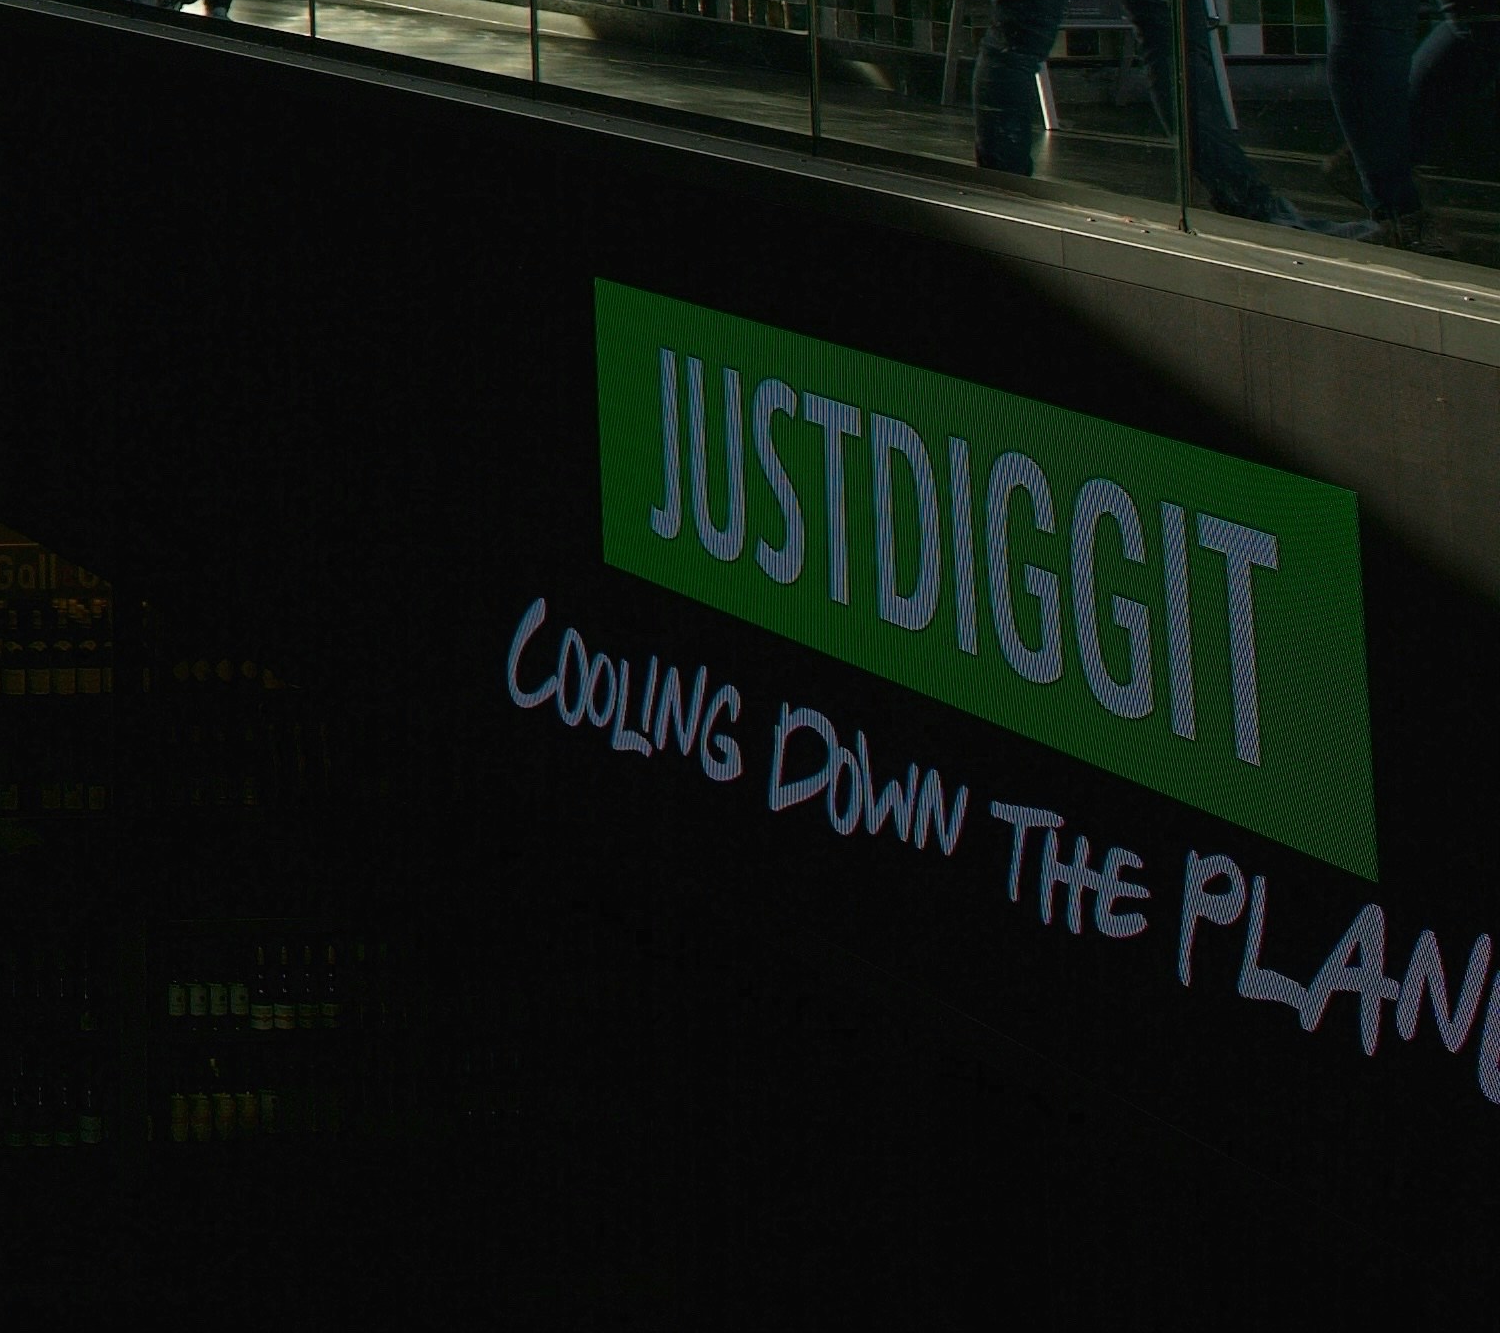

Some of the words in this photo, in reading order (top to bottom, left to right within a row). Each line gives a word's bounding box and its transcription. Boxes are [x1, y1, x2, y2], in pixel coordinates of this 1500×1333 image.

[650, 346, 1278, 767] JUSTDIGGIT
[505, 596, 743, 783] COOLING
[767, 701, 970, 856] DOWN
[990, 800, 1151, 939] THE
[1177, 849, 1500, 1106] PLAN
